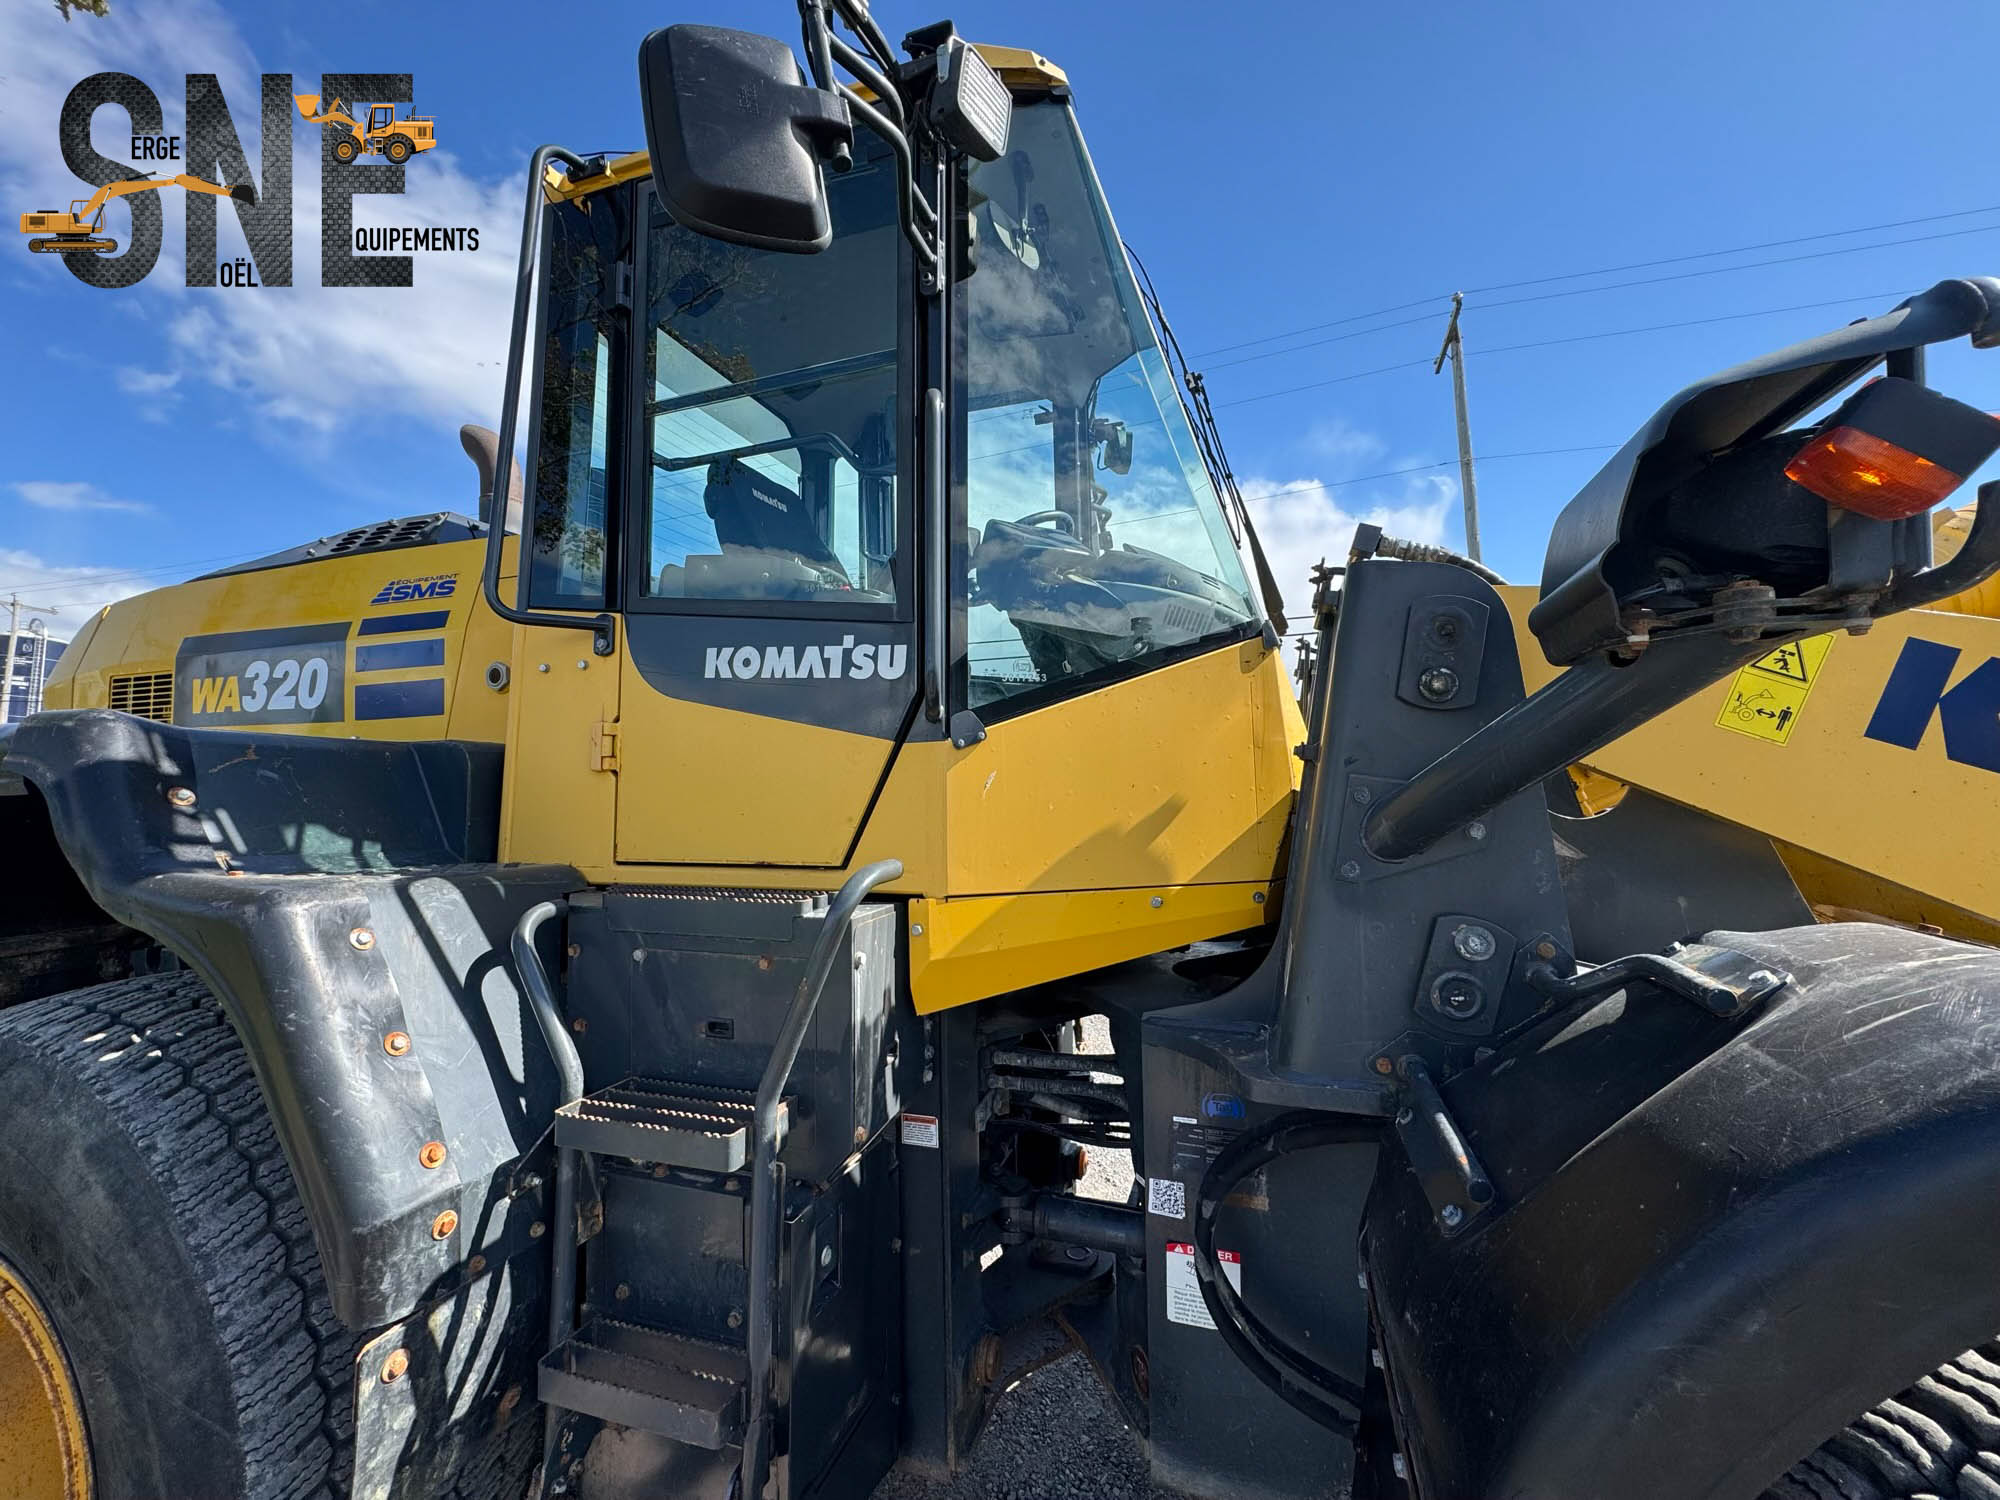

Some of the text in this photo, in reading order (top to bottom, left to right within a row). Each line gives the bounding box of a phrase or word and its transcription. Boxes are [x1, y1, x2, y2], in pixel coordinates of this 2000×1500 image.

[391, 580, 457, 601] SMS
[396, 573, 459, 586] EQUIPEMENT
[704, 634, 908, 680] KOMATSU
[192, 657, 329, 714] WA320
